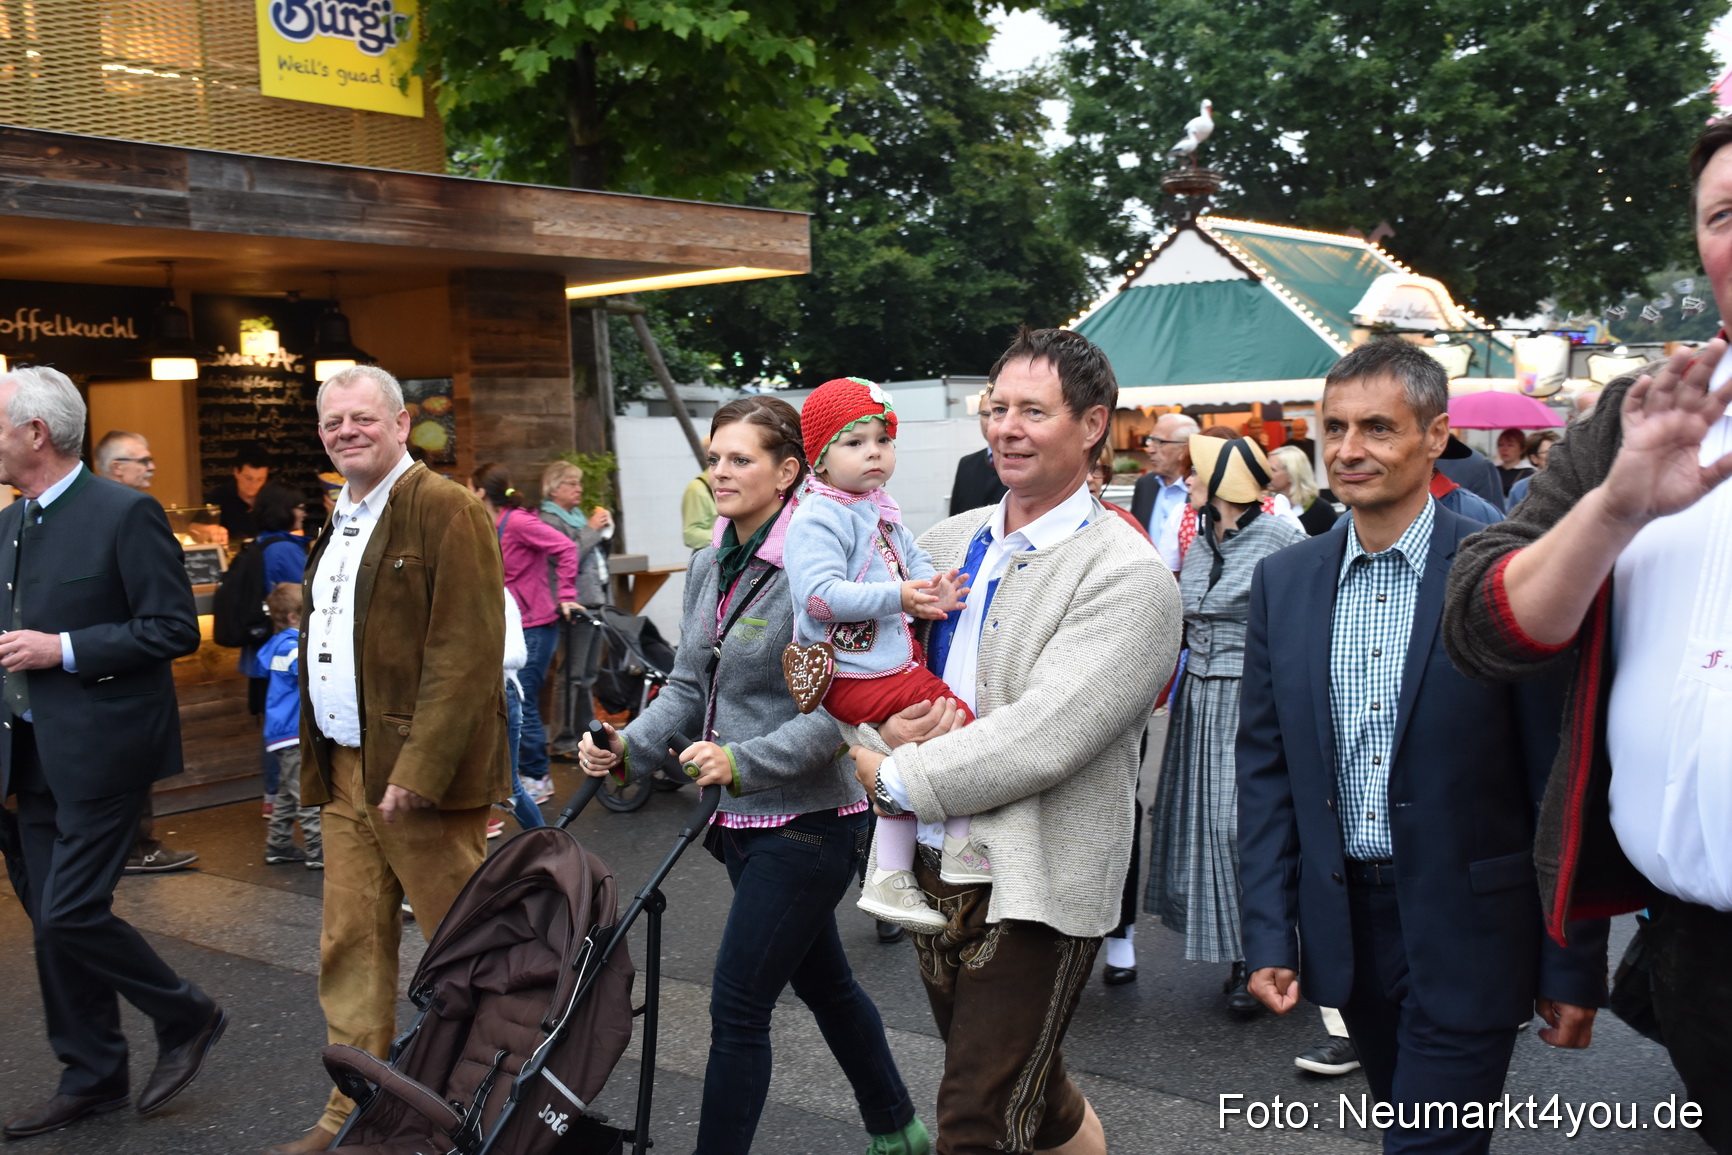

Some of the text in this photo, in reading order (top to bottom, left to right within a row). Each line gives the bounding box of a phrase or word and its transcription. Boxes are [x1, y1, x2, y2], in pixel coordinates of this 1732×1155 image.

[270, 0, 410, 55] Burgi
[278, 55, 329, 77] Weil's
[336, 68, 382, 86] guad
[0, 307, 138, 342] offelkuchl
[538, 1103, 569, 1136] Joie
